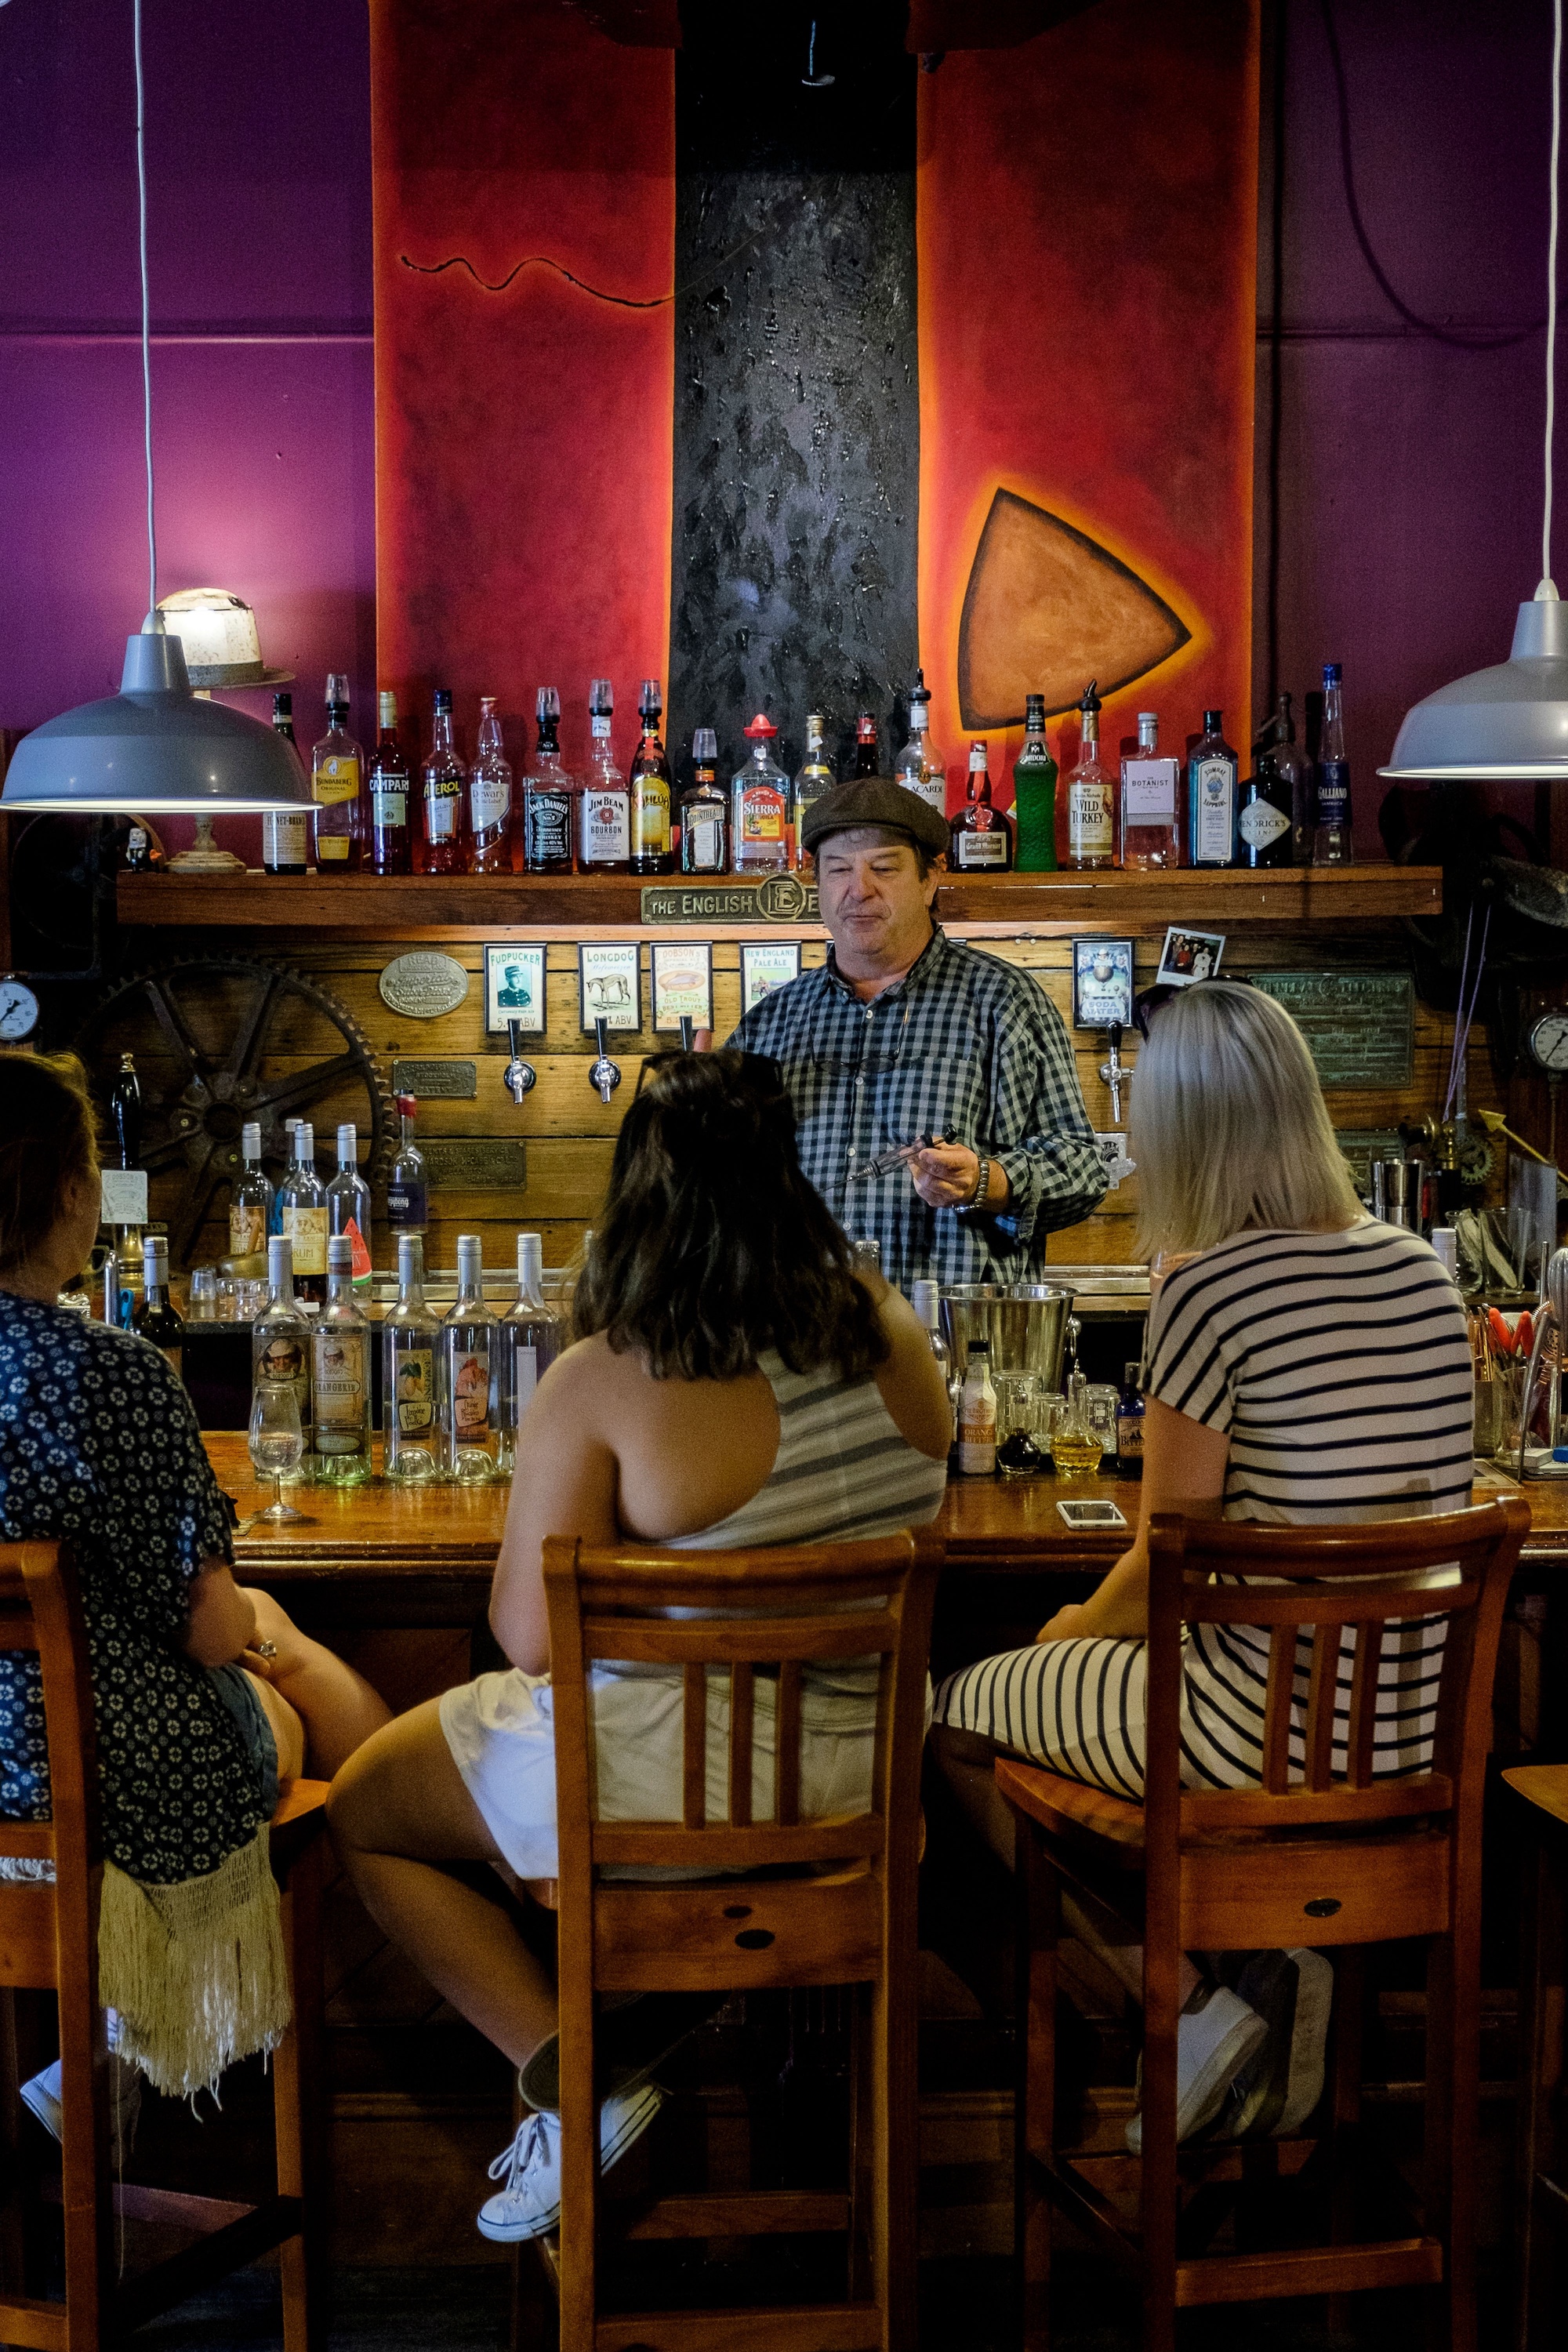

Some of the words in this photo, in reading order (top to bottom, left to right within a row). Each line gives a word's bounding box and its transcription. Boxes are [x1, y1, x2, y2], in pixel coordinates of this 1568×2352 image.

[316, 776, 352, 786] BUNDABERG
[368, 779, 409, 791] CAMPARI
[423, 781, 460, 797] AEROL
[911, 785, 942, 793] ACARDI
[1317, 786, 1348, 800] GALLIANO
[529, 800, 545, 814] JACK
[544, 798, 569, 815] DANIEL'S
[588, 798, 603, 811] JIM
[604, 796, 623, 812] BEAM
[743, 801, 781, 815] SIERRA
[1075, 799, 1099, 811] WILD
[688, 808, 721, 826] COINTREAU
[1072, 811, 1105, 824] TURKEY
[590, 826, 622, 834] BOURBON
[650, 901, 676, 914] THE
[682, 894, 753, 915] ENGLISH
[490, 951, 540, 966] FUDPUCKER
[586, 949, 634, 963] LONGDOG
[746, 949, 760, 957] NEW
[762, 948, 795, 956] ENGLAND
[753, 958, 771, 967] PALE
[773, 957, 787, 966] ALE
[679, 995, 701, 1004] TROUT
[615, 1014, 632, 1025] ABV
[292, 1247, 314, 1258] RUM
